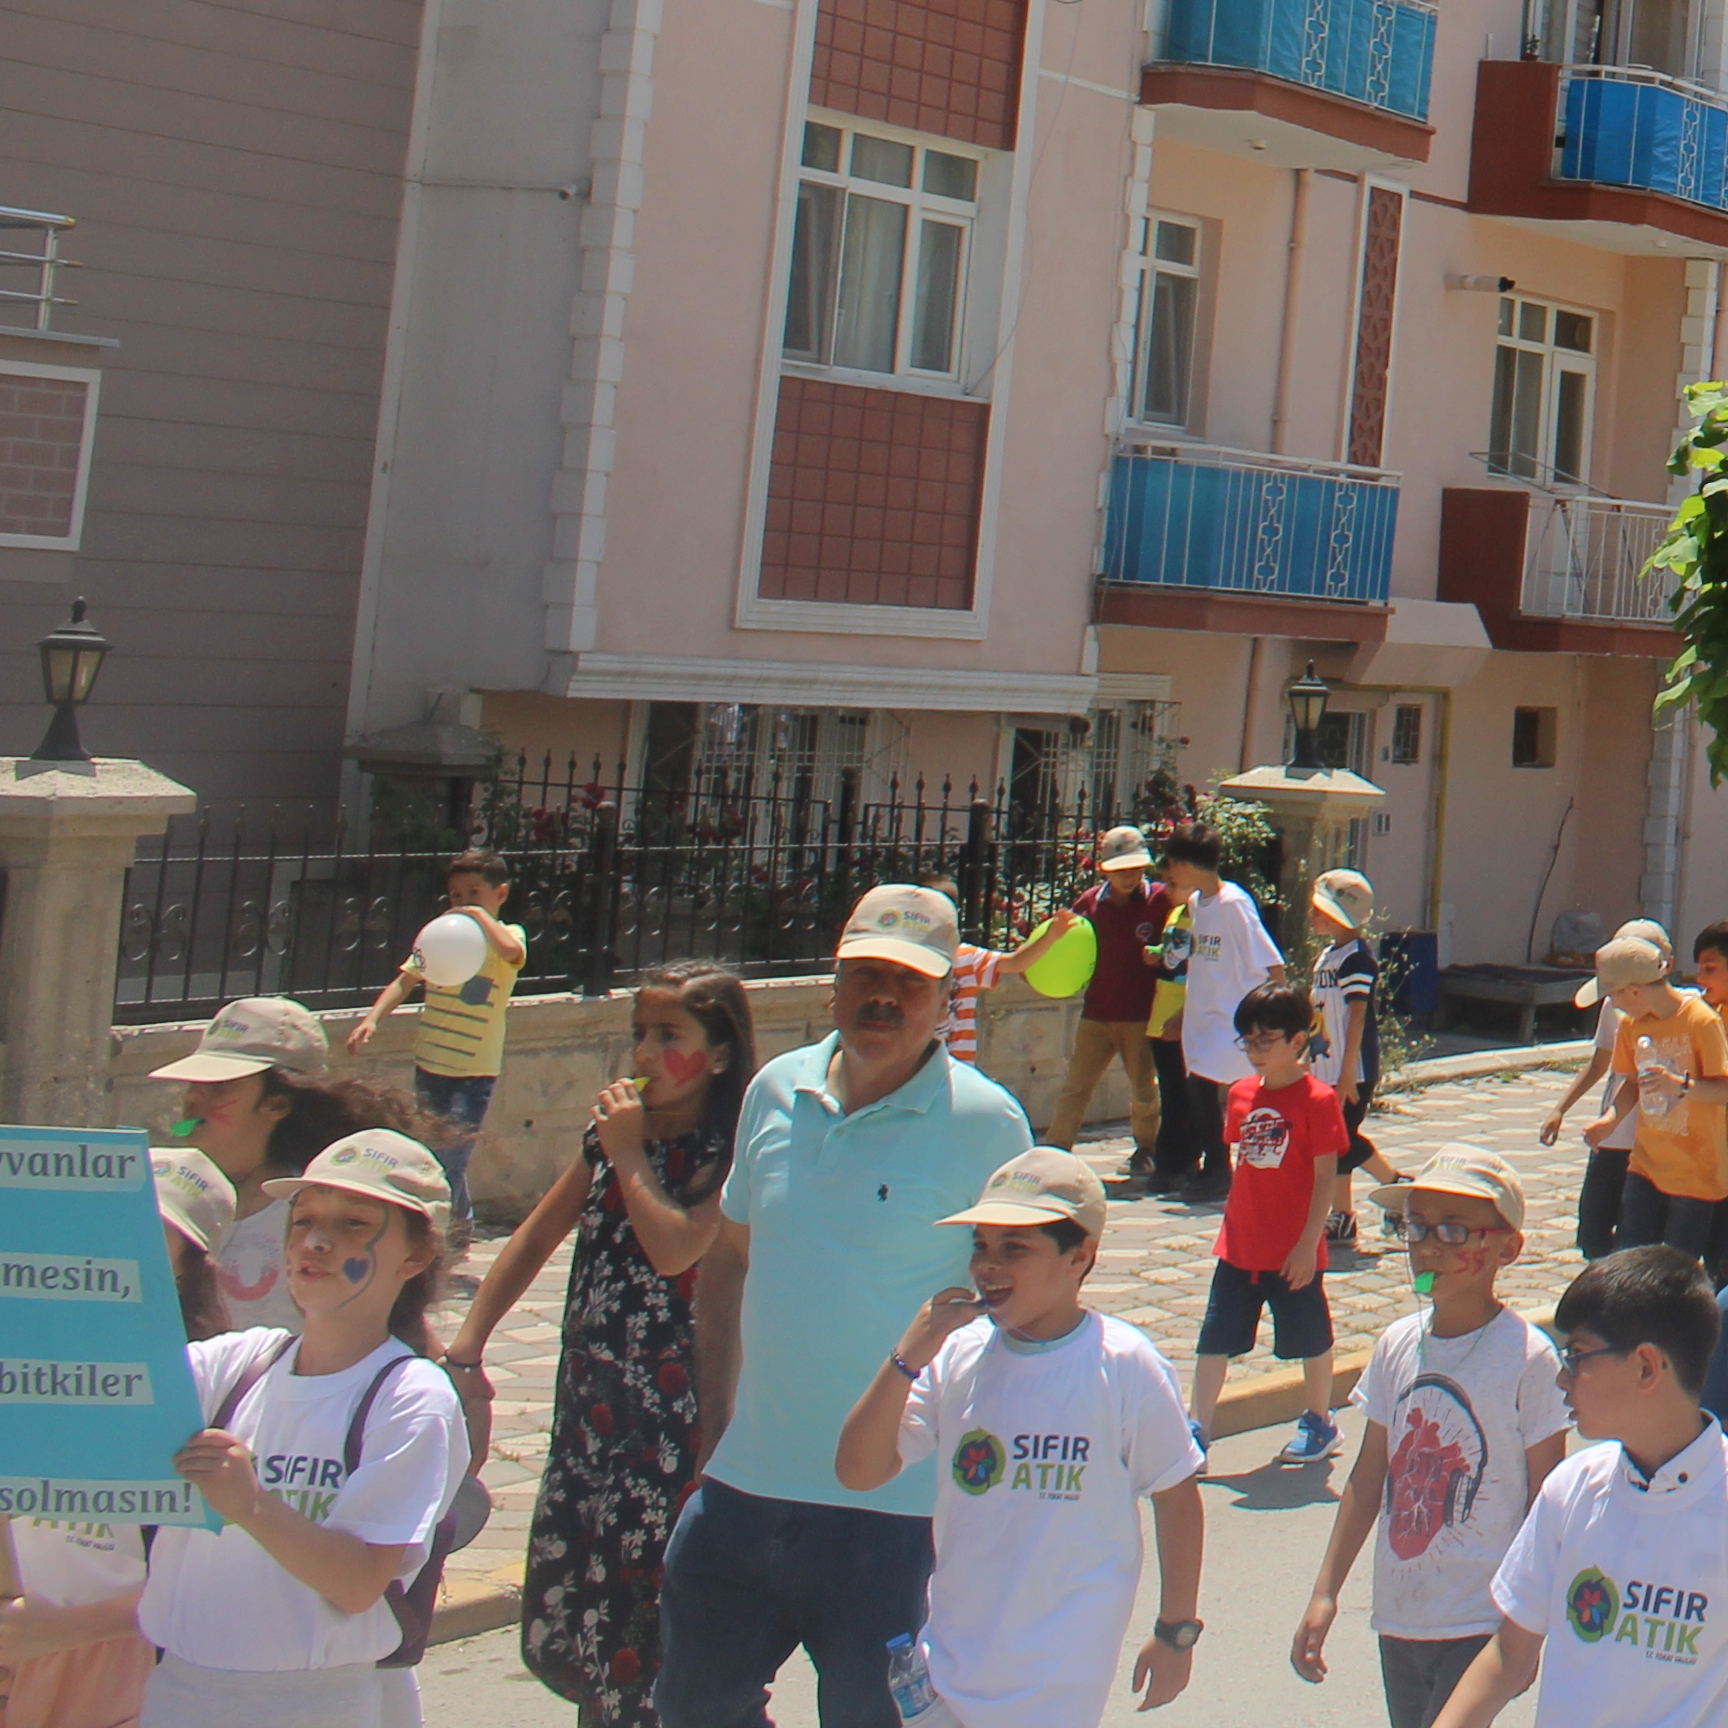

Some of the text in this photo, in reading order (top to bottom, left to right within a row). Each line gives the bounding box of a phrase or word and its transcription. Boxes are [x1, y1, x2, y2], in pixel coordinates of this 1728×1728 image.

[363, 1146, 399, 1169] SIFIR
[178, 1165, 209, 1191] SIFIR
[0, 1360, 143, 1398] bitkiler
[1013, 1434, 1091, 1462] SIFIR
[1011, 1462, 1088, 1492] ATIK
[0, 1478, 192, 1513] solmasın!
[1623, 1580, 1710, 1622] SIFIR
[1615, 1613, 1705, 1655] ATIK
